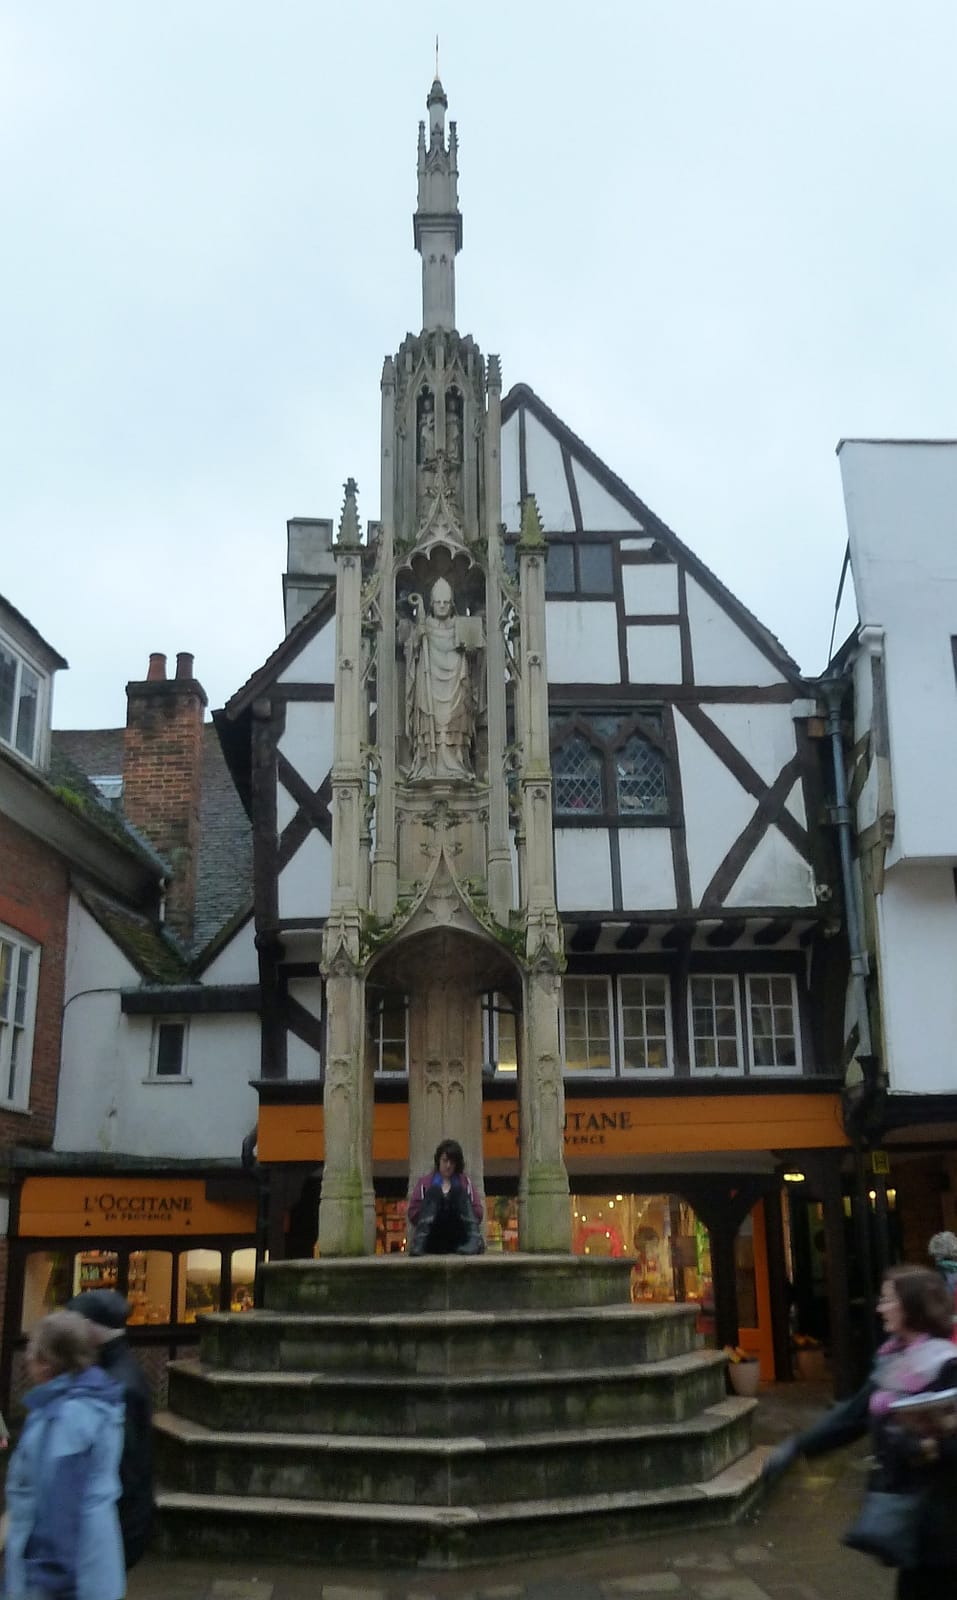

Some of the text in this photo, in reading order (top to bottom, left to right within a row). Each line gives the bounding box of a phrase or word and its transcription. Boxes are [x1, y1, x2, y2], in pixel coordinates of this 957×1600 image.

[485, 1110, 631, 1132] L'OITANE
[563, 1135, 606, 1145] VENCE
[84, 1194, 192, 1212] L'OCCITANE
[105, 1212, 172, 1221] EN PROVENCE
